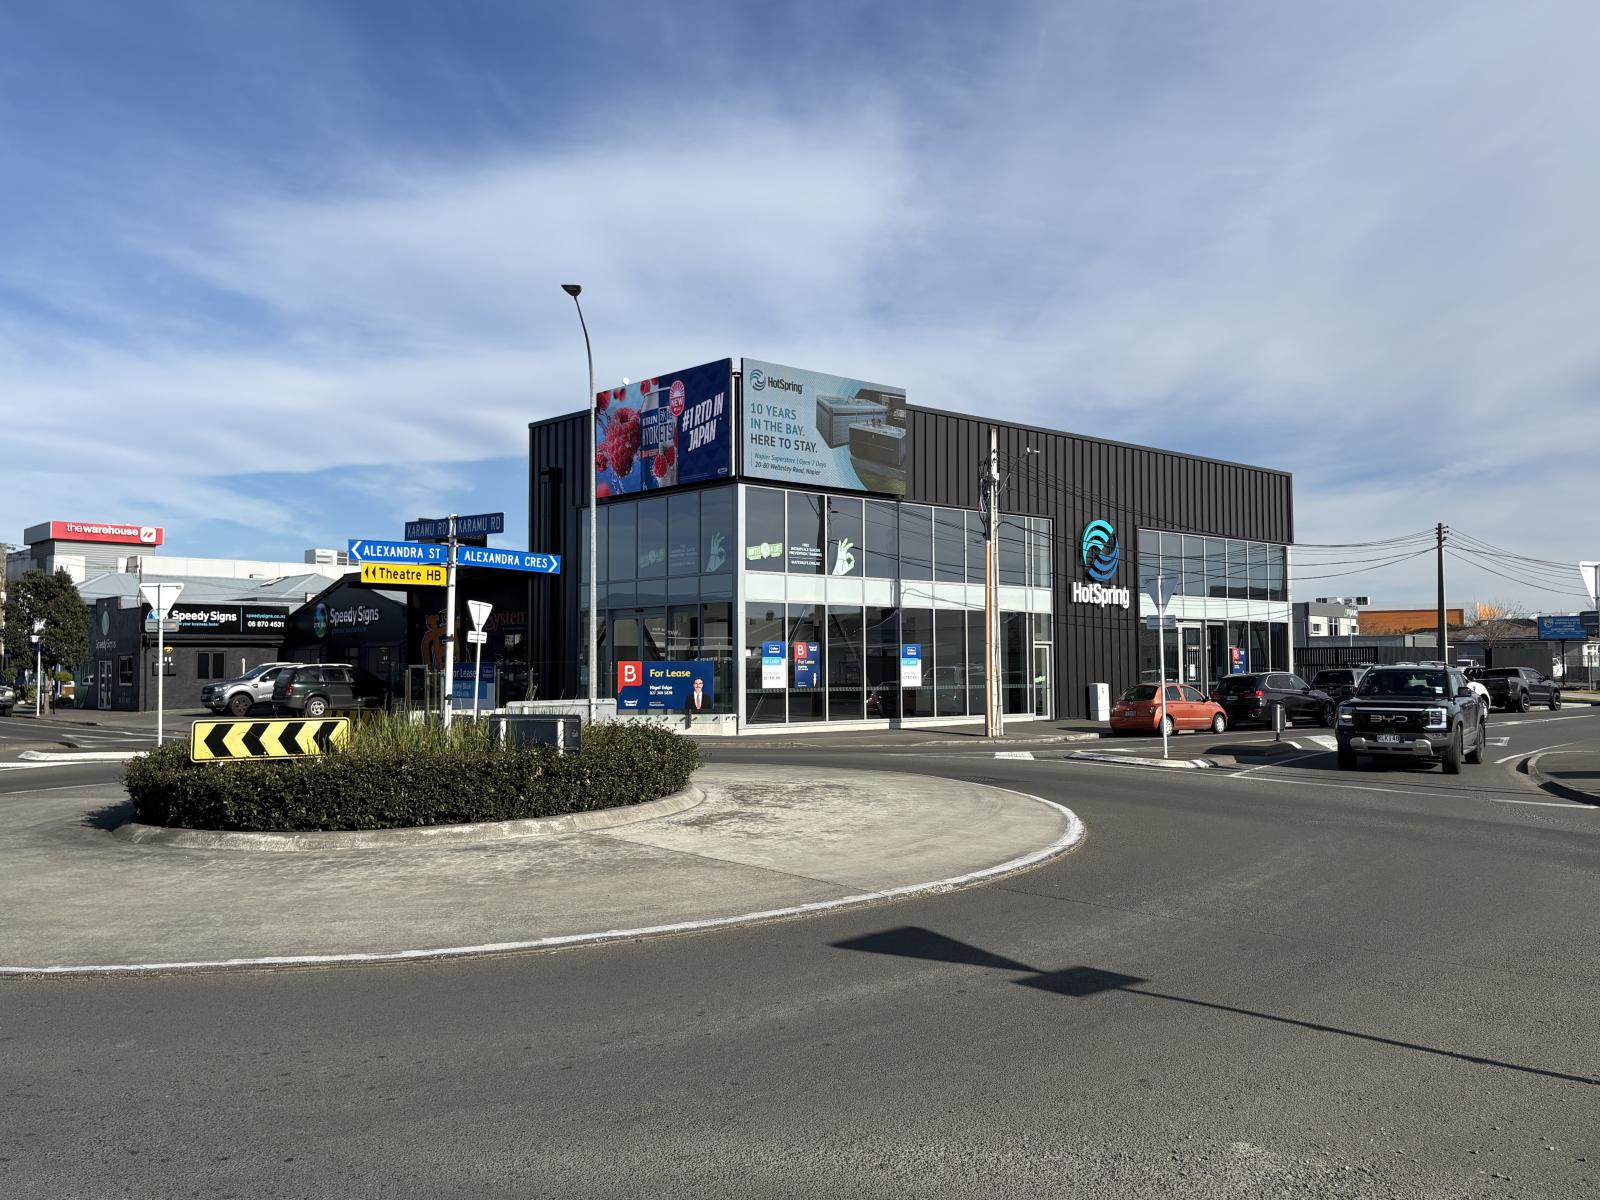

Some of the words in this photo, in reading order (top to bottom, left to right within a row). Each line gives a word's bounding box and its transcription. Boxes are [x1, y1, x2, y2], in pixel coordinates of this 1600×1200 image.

[767, 376, 803, 394] HotSpring
[671, 397, 683, 406] NEW
[694, 399, 713, 427] RTD
[713, 392, 724, 418] IN
[751, 402, 763, 415] 10
[765, 405, 797, 421] YEARS
[687, 419, 717, 452] JAPAN
[750, 417, 761, 430] IN
[763, 420, 782, 433] THE
[785, 424, 806, 437] BAY.
[750, 433, 776, 447] HERE
[778, 437, 792, 450] TO
[794, 440, 818, 454] STAY.
[407, 523, 435, 537] KARAMU
[437, 522, 448, 536] RD
[458, 517, 487, 533] KARAMU
[490, 516, 501, 531] RD
[363, 545, 423, 558] ALEXANDRA
[428, 547, 441, 559] ST
[464, 550, 520, 566] ALEXANDRA
[524, 556, 548, 569] CRES
[379, 567, 422, 581] Theatre
[426, 569, 441, 581] HB
[1073, 582, 1130, 609] HotSpring
[172, 610, 209, 622] Speedy
[210, 611, 237, 622] Signs
[329, 606, 357, 627] Speedy
[357, 605, 379, 625] Signs
[797, 644, 805, 656] B
[460, 668, 477, 679] Lease
[624, 665, 637, 682] B
[649, 669, 664, 678] For
[666, 668, 691, 678] Lease
[1370, 714, 1408, 723] BYD
